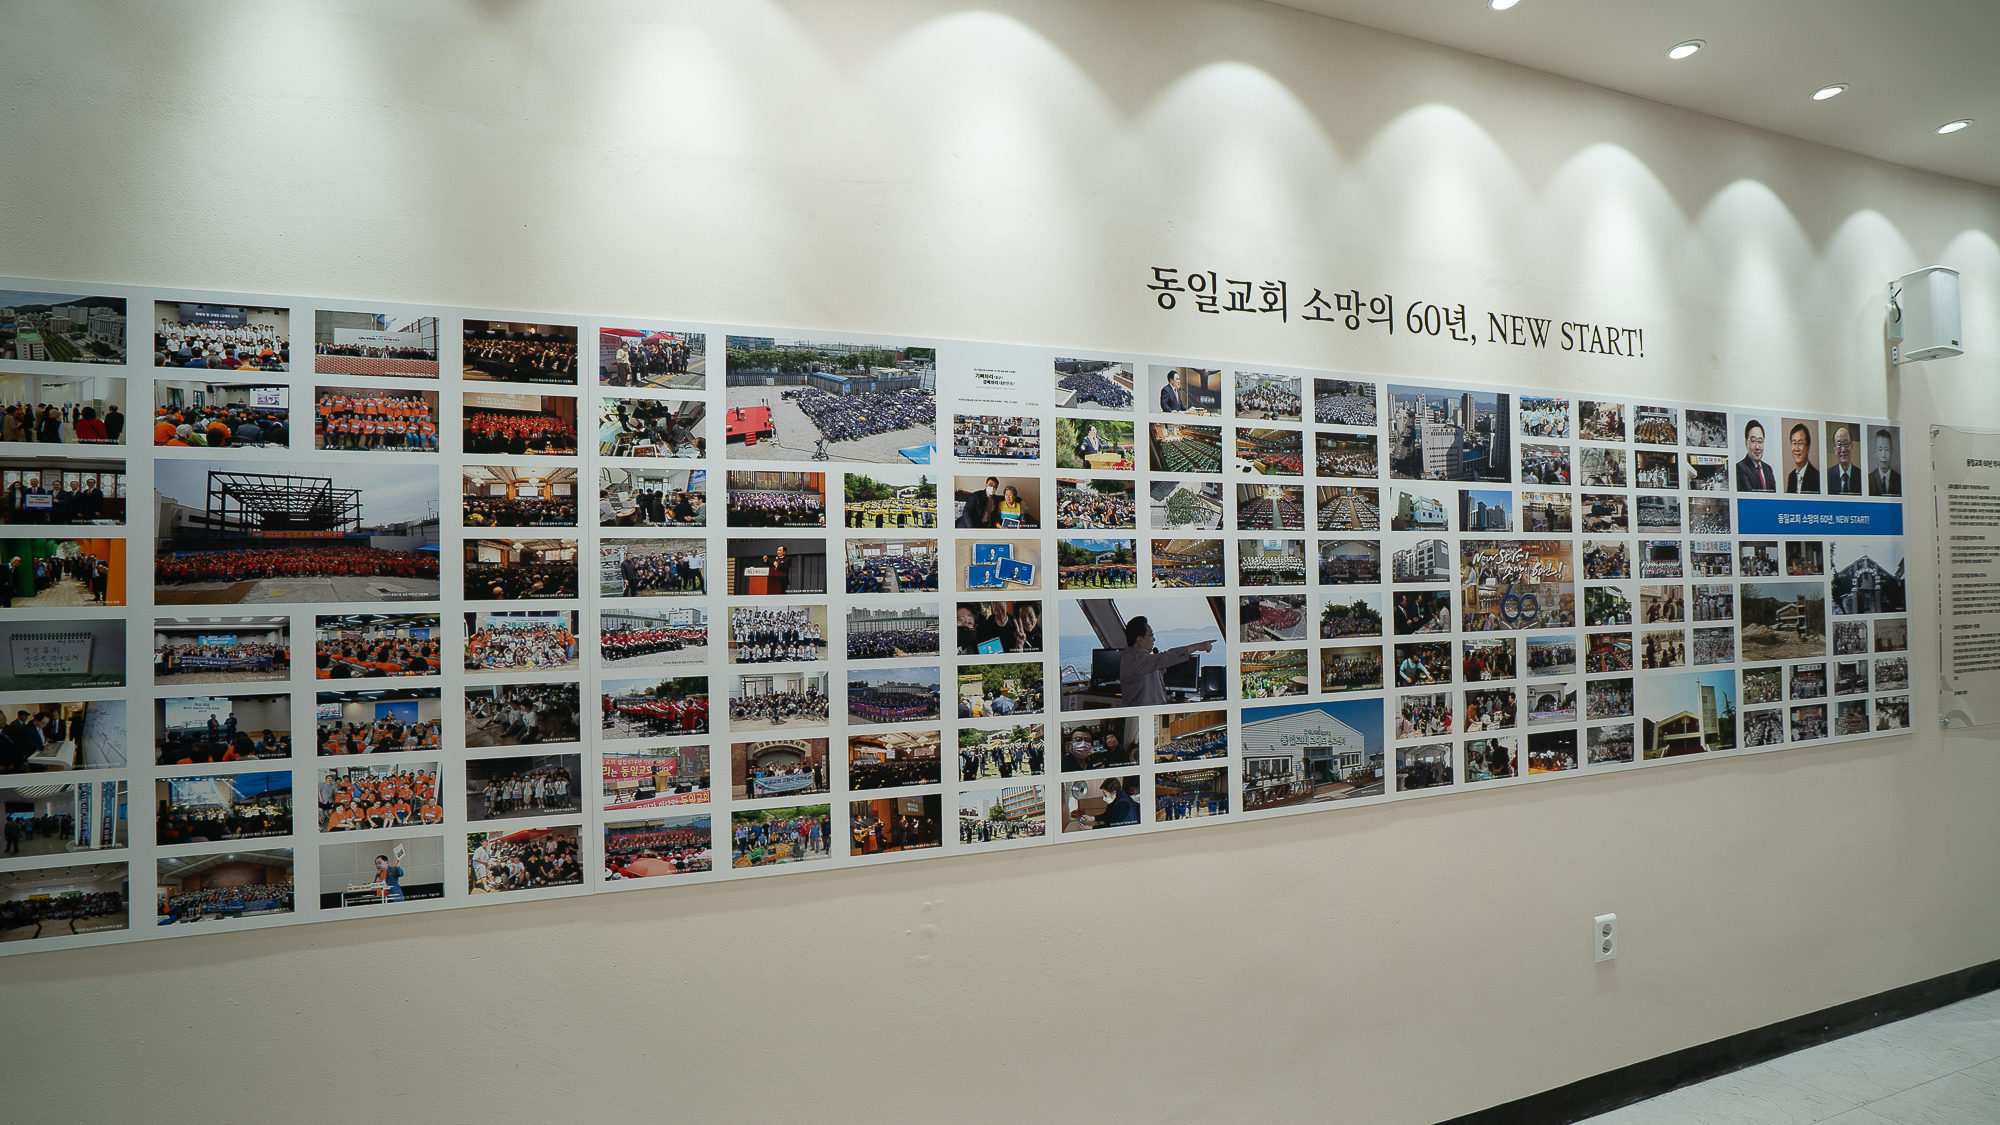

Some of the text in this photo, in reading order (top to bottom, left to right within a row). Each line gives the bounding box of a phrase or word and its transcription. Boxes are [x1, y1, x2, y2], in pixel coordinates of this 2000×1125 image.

[1147, 266, 1645, 358] 동일교회 소망의 60년, NEW START!
[1778, 513, 1801, 524] 동일교회
[1802, 514, 1819, 524] 소망의
[1820, 514, 1834, 524] 60년,
[1850, 516, 1870, 524] START!
